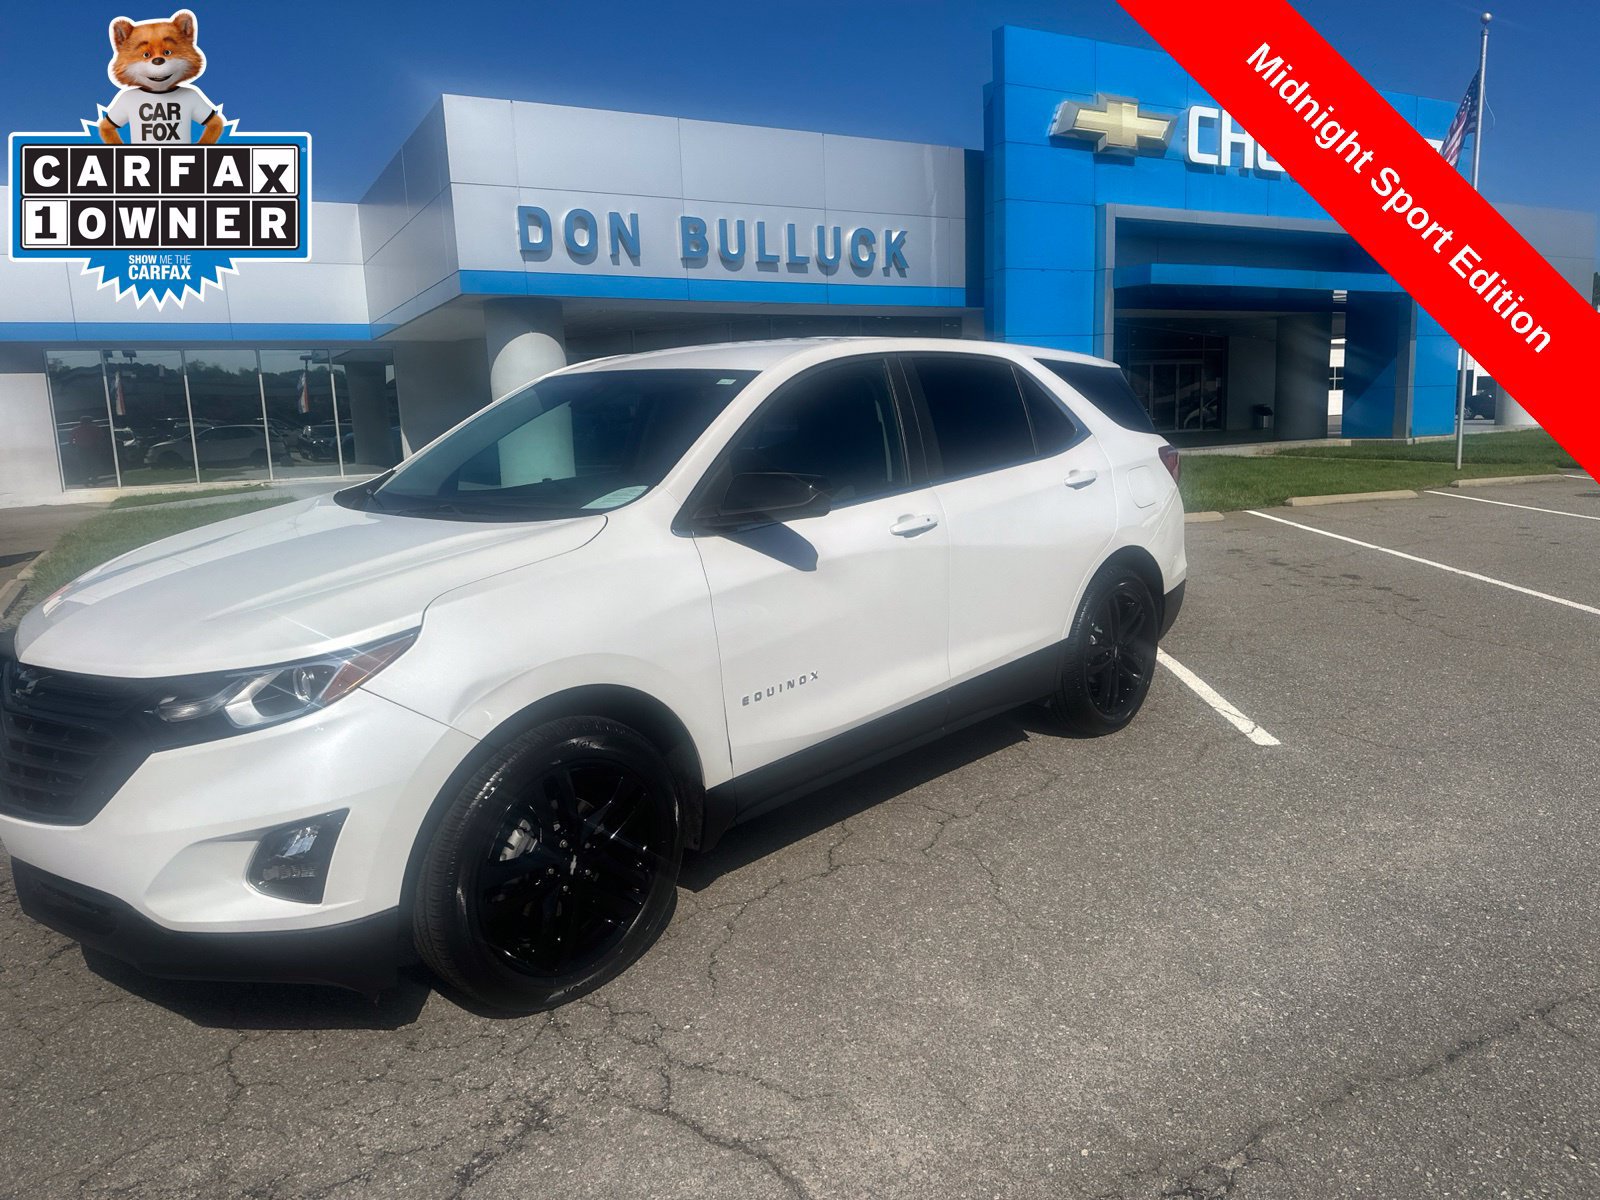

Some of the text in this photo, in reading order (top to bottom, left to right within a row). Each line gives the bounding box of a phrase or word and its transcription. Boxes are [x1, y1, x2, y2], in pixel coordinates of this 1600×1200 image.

[516, 205, 909, 269] DON BULLUCK
[741, 670, 819, 707] EQUINOX
